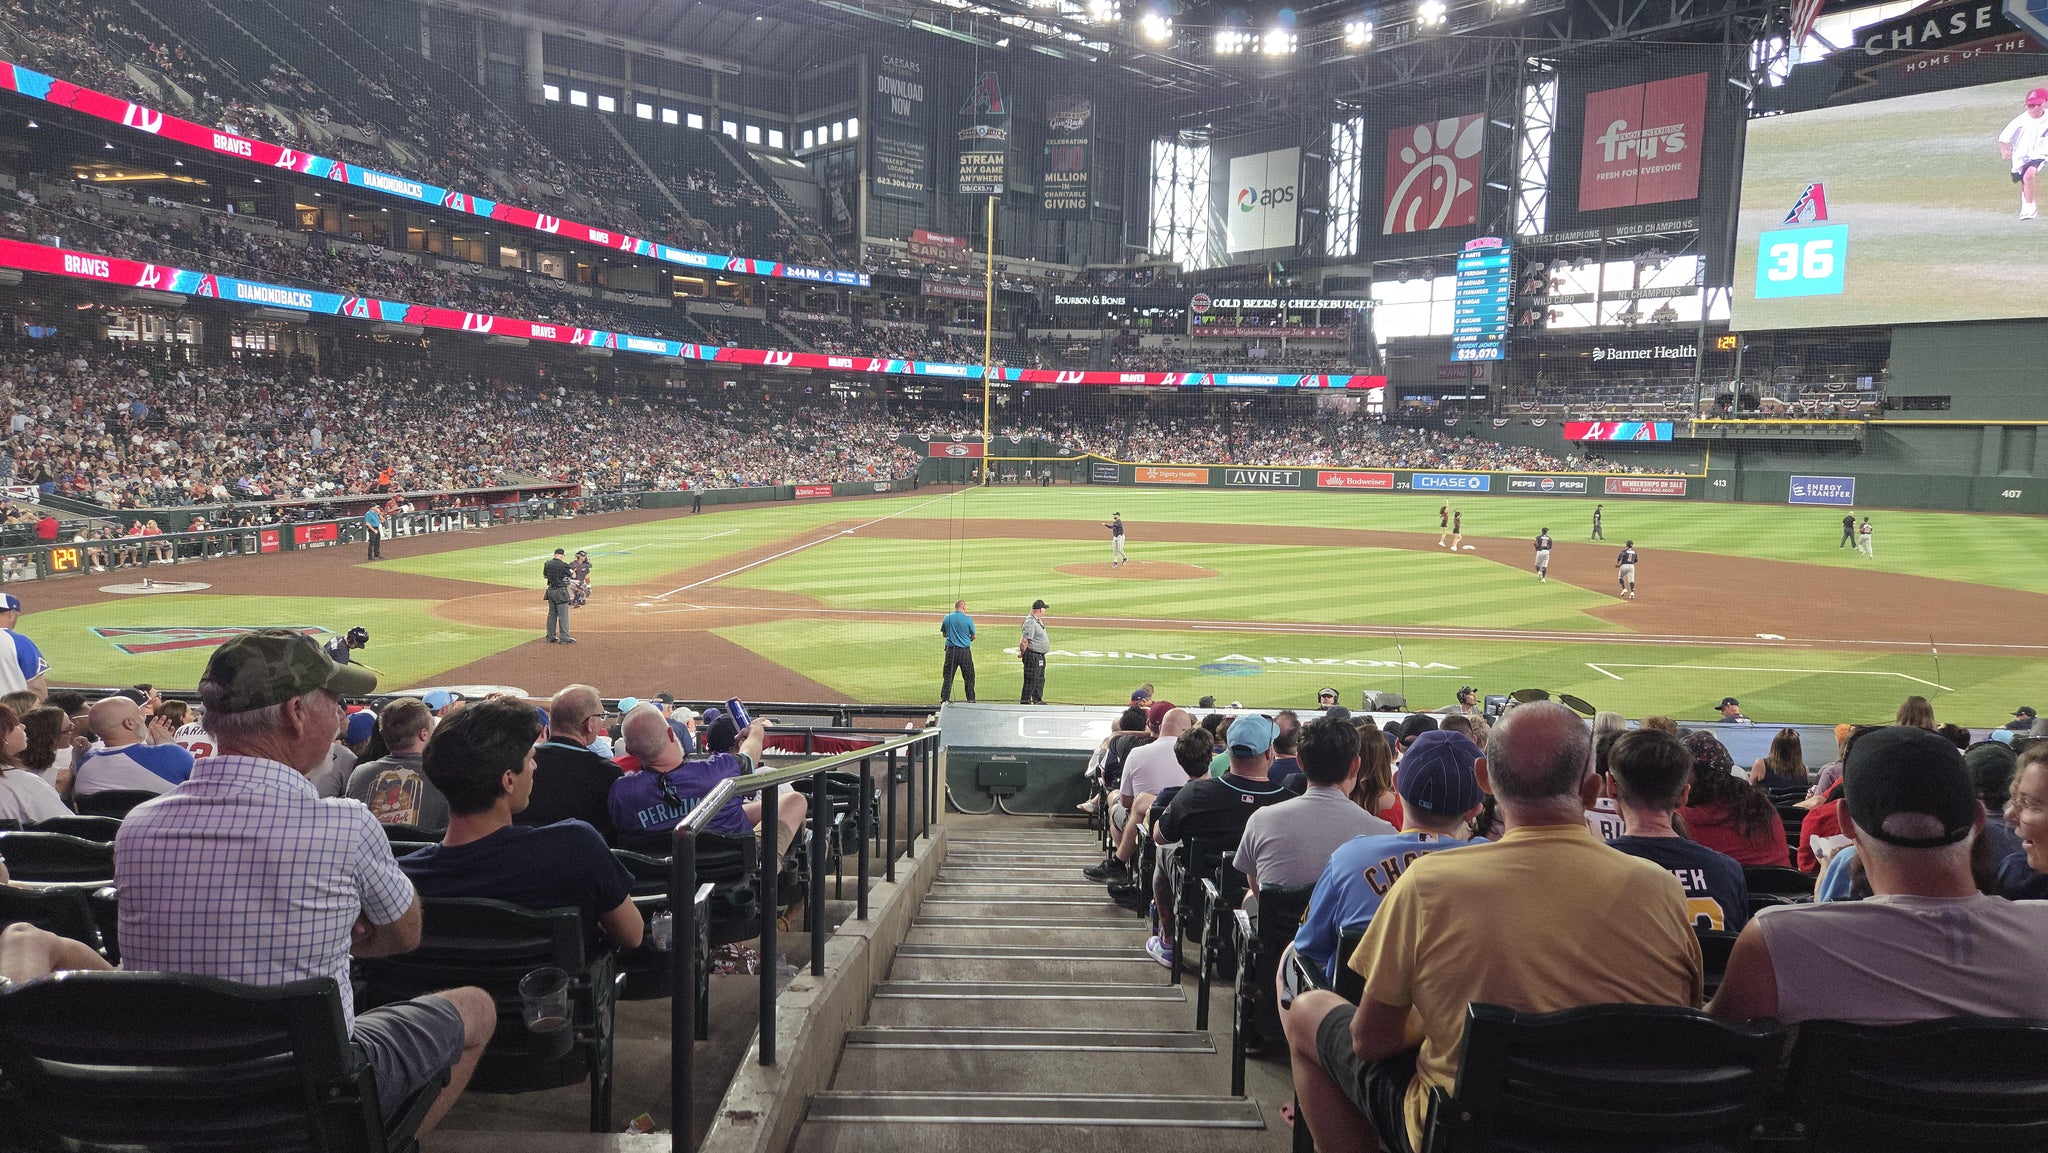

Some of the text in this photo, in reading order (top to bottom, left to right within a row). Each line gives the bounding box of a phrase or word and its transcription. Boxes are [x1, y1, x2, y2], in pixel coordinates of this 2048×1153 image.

[1864, 6, 1992, 56] CHASE
[1906, 39, 2026, 72] HOME OF THE
[882, 54, 920, 73] CAESARS
[878, 75, 923, 102] DOWNLOAD
[891, 96, 911, 117] NOW
[213, 134, 253, 158] BRAVES
[960, 155, 1004, 165] STREAM
[887, 165, 914, 175] LOCATION
[960, 166, 1004, 174] ANY GAME
[1596, 163, 1682, 181] FRESH FOR EVERYONE
[877, 176, 923, 191] 623.304.0777
[960, 174, 1004, 182] ANYWHERE
[1045, 172, 1087, 182] MILLION
[363, 171, 423, 199] DIAMONDBACKS
[1260, 185, 1294, 209] aps
[1044, 199, 1086, 209] GIVING
[1616, 220, 1693, 235] WORLD CHAMPIONS
[926, 233, 955, 244] Honeywell
[1533, 235, 1553, 244] WEST
[1555, 230, 1600, 242] CHAMPIONS
[64, 255, 110, 279] BRAVES
[1767, 239, 1834, 282] 36
[786, 267, 820, 279] 2:44 PM
[237, 284, 313, 309] DIAMONDBACKS
[1055, 294, 1126, 305] BOURBON & BONES
[1618, 287, 1682, 300] NL CHAMPIONS
[1213, 298, 1241, 308] COLD
[1243, 298, 1278, 308] BEERS
[1280, 298, 1286, 308] &
[1288, 299, 1382, 310] CHEESEBURGERS
[1533, 295, 1575, 306] WILD CARD
[531, 324, 557, 339] BRAVES
[1236, 327, 1271, 336] Neighborhood
[1272, 328, 1290, 337] Burger
[1291, 328, 1306, 336] Joint
[1717, 335, 1737, 349] 1:29
[1457, 348, 1498, 360] $29,070
[1606, 345, 1697, 360] Banner Health
[1233, 471, 1293, 484] AVNET
[1346, 477, 1387, 487] Budweiser
[1421, 477, 1466, 488] CHASE
[1621, 480, 1659, 488] MEMBERSHIPS
[1396, 482, 1410, 490] 374
[1807, 483, 1842, 491] ENERGY
[1807, 490, 1850, 498] TRANSFER
[2001, 490, 2022, 498] 407
[1215, 653, 1462, 670] ARIZONA
